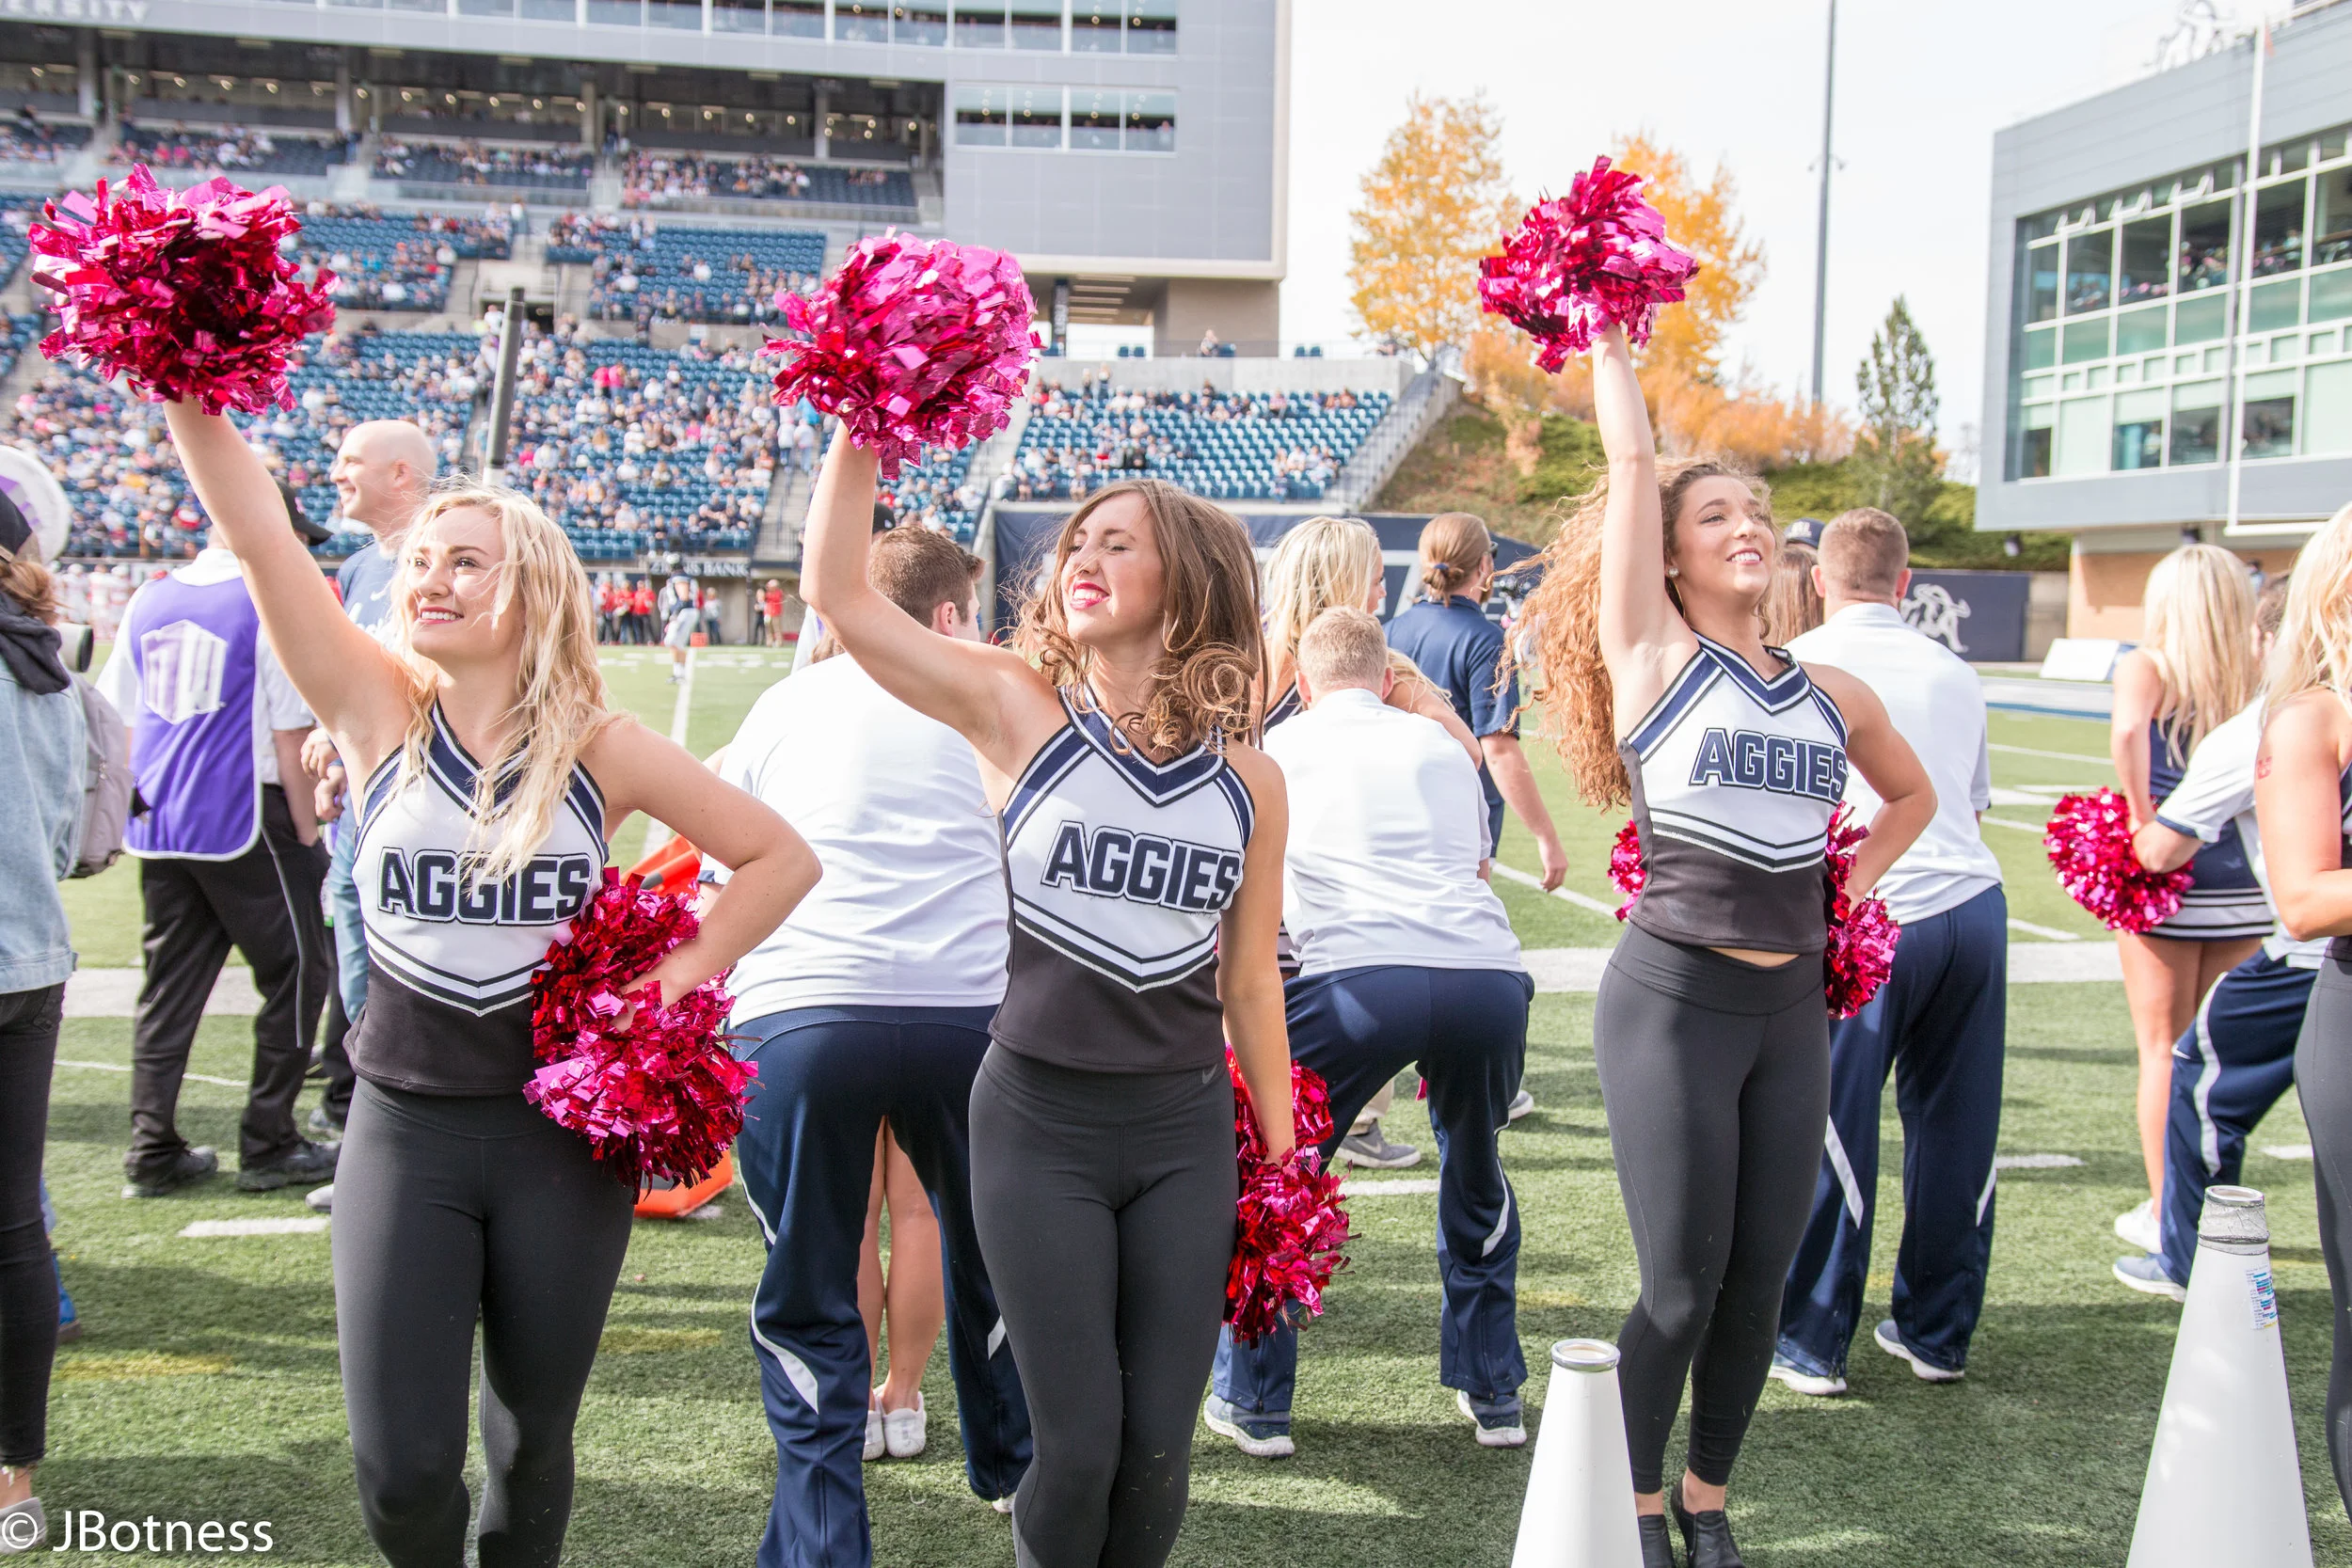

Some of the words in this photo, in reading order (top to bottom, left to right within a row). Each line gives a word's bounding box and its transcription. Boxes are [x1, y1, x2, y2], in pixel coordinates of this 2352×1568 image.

[703, 561, 750, 577] BANK
[1689, 728, 1849, 806] AGGIES
[377, 847, 593, 927] AGGIES
[1041, 820, 1239, 914] AGGIES
